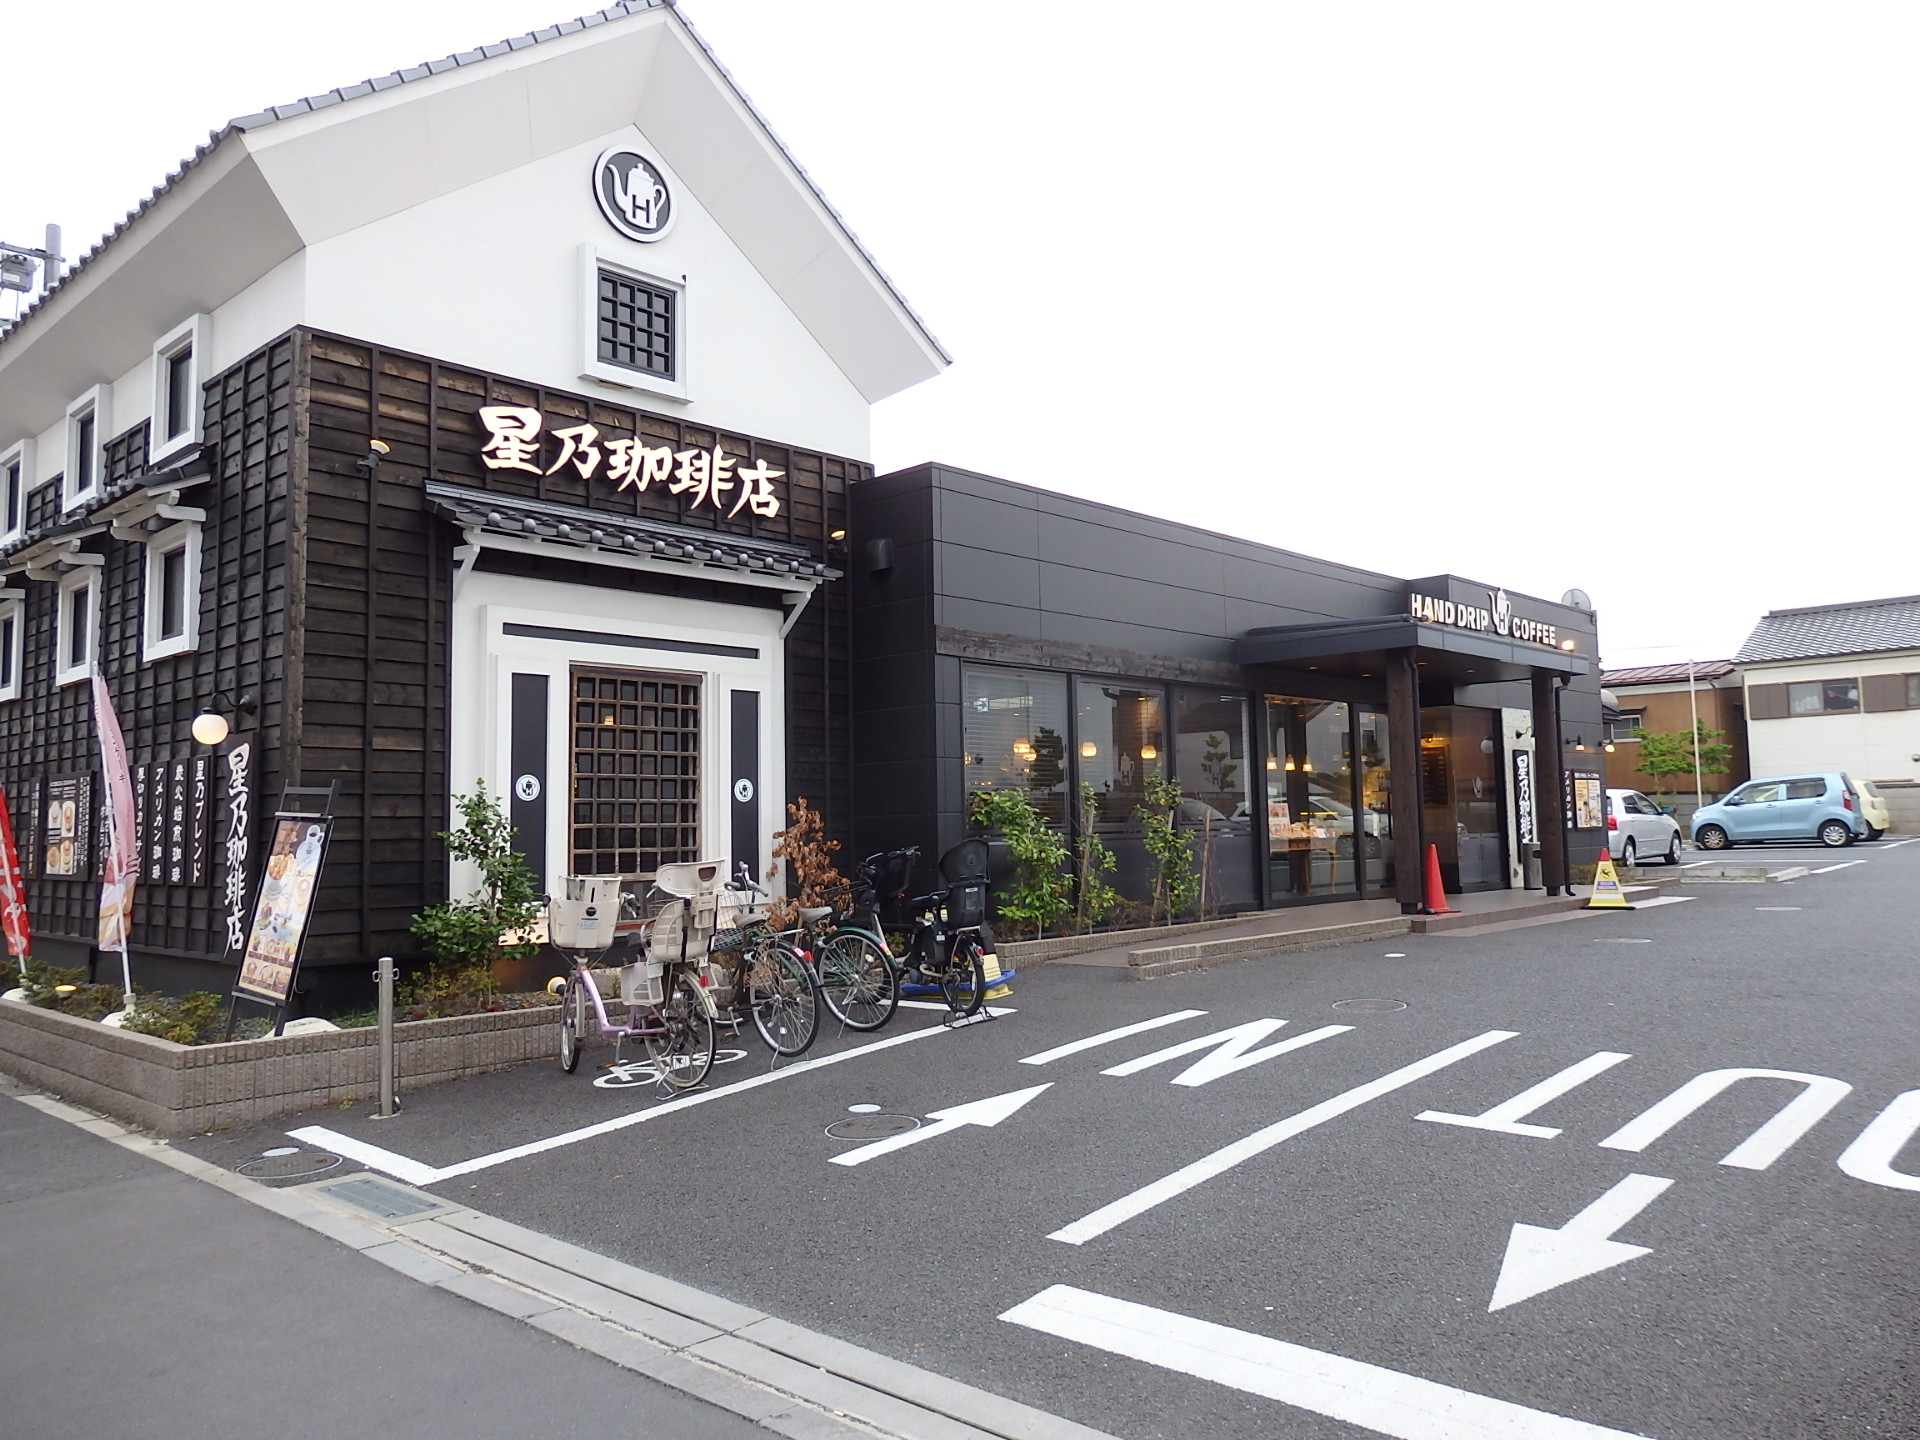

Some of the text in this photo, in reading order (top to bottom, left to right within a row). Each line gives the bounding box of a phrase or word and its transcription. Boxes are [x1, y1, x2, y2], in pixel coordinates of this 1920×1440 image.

[478, 405, 786, 519] 星乃珈琲店
[1410, 592, 1455, 625] HAND
[1456, 604, 1489, 632] DRIP
[1511, 617, 1557, 646] COFFEE
[151, 767, 165, 880] アメリカン珈琲
[192, 760, 206, 884] 星乃ブレンド
[223, 742, 251, 959] 星乃珈琲店
[1017, 1008, 1356, 1087] IN
